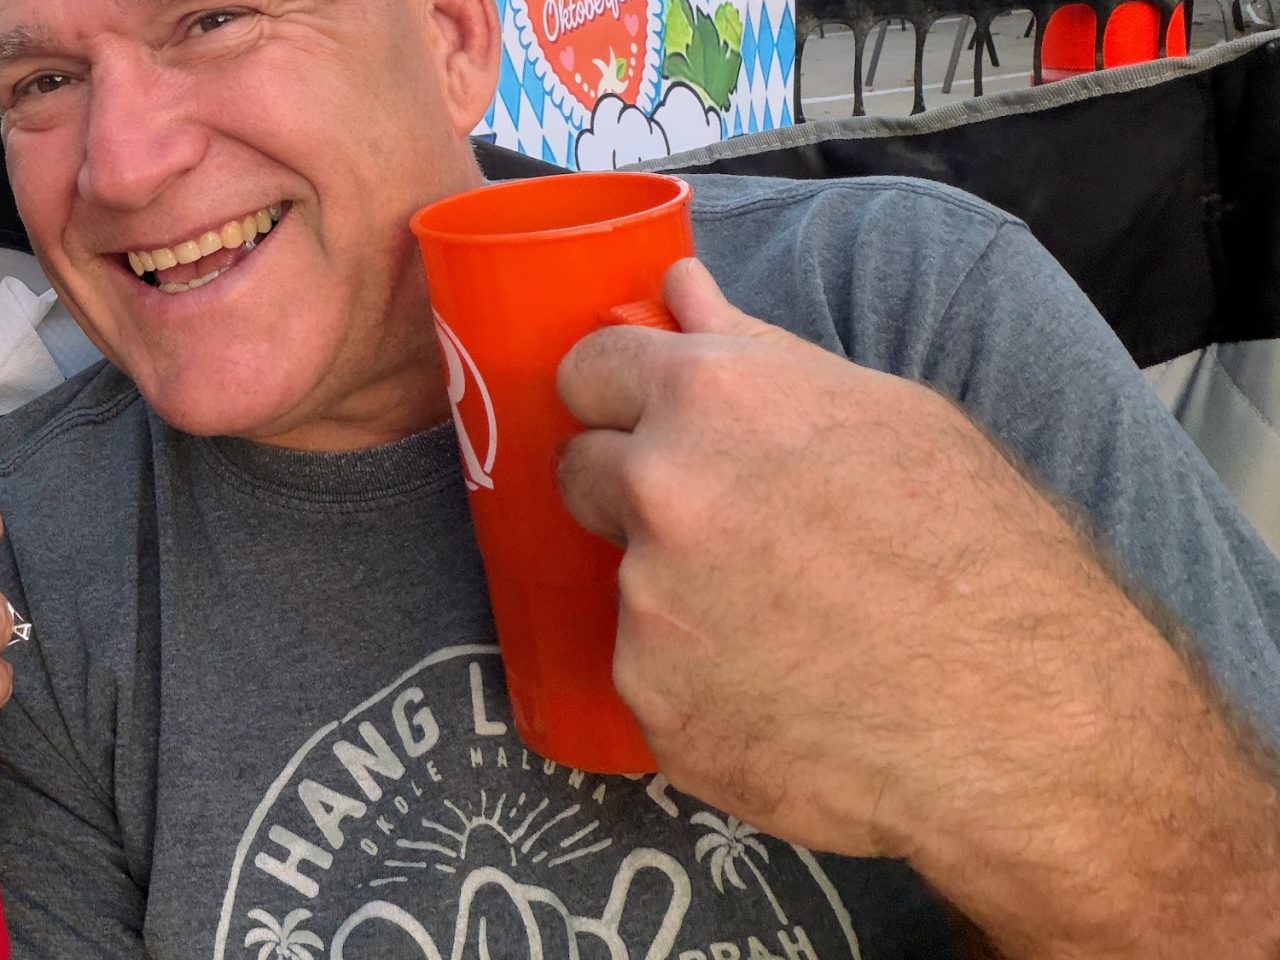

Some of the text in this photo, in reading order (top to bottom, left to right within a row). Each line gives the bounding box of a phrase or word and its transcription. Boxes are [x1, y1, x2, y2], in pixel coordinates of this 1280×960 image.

[254, 686, 440, 899] HANG
[359, 746, 607, 857] OKOLE MALUNA
